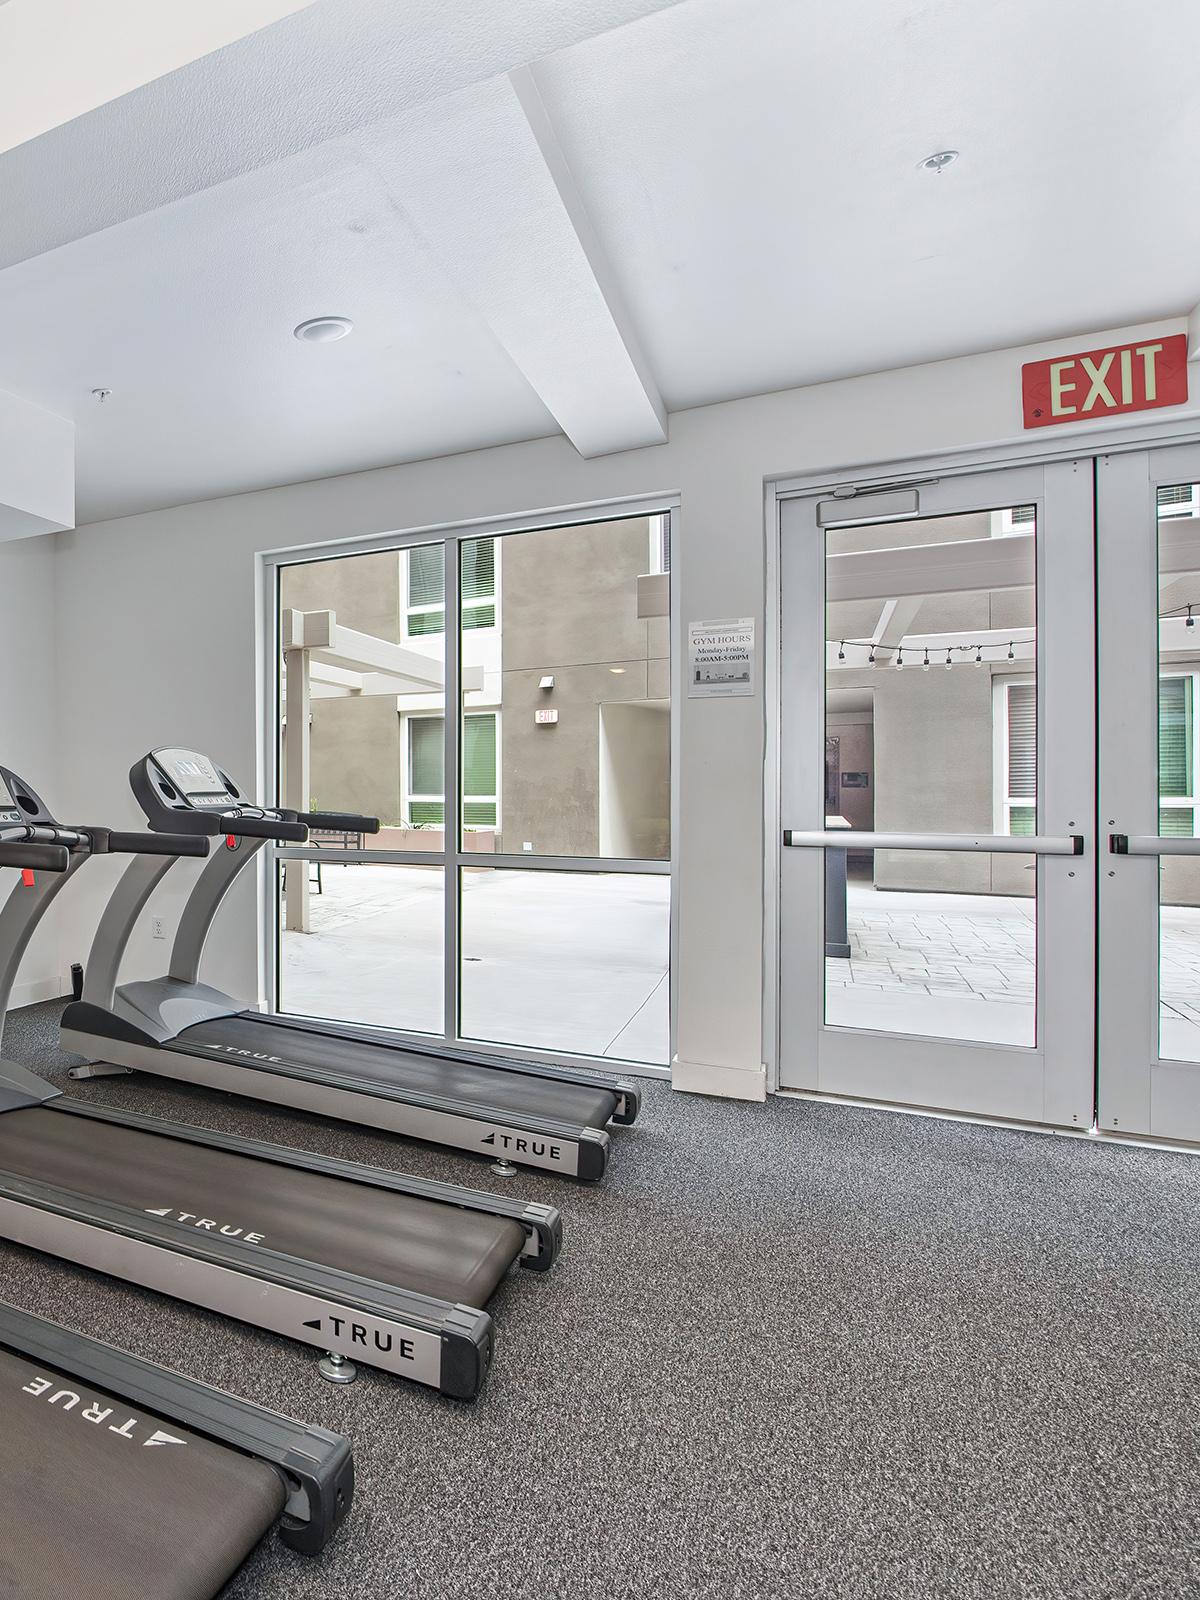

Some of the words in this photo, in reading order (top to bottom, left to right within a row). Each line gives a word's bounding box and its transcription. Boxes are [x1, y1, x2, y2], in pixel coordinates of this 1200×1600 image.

[1050, 343, 1163, 417] EXIT
[693, 637, 716, 645] GYM
[718, 634, 752, 644] HOURS
[539, 710, 554, 721] EXIT
[226, 1046, 282, 1061] TRUE
[500, 1134, 561, 1160] TRUE
[177, 1211, 266, 1244] TRUE
[329, 1315, 415, 1361] TRUE
[21, 1376, 138, 1440] TRUE
